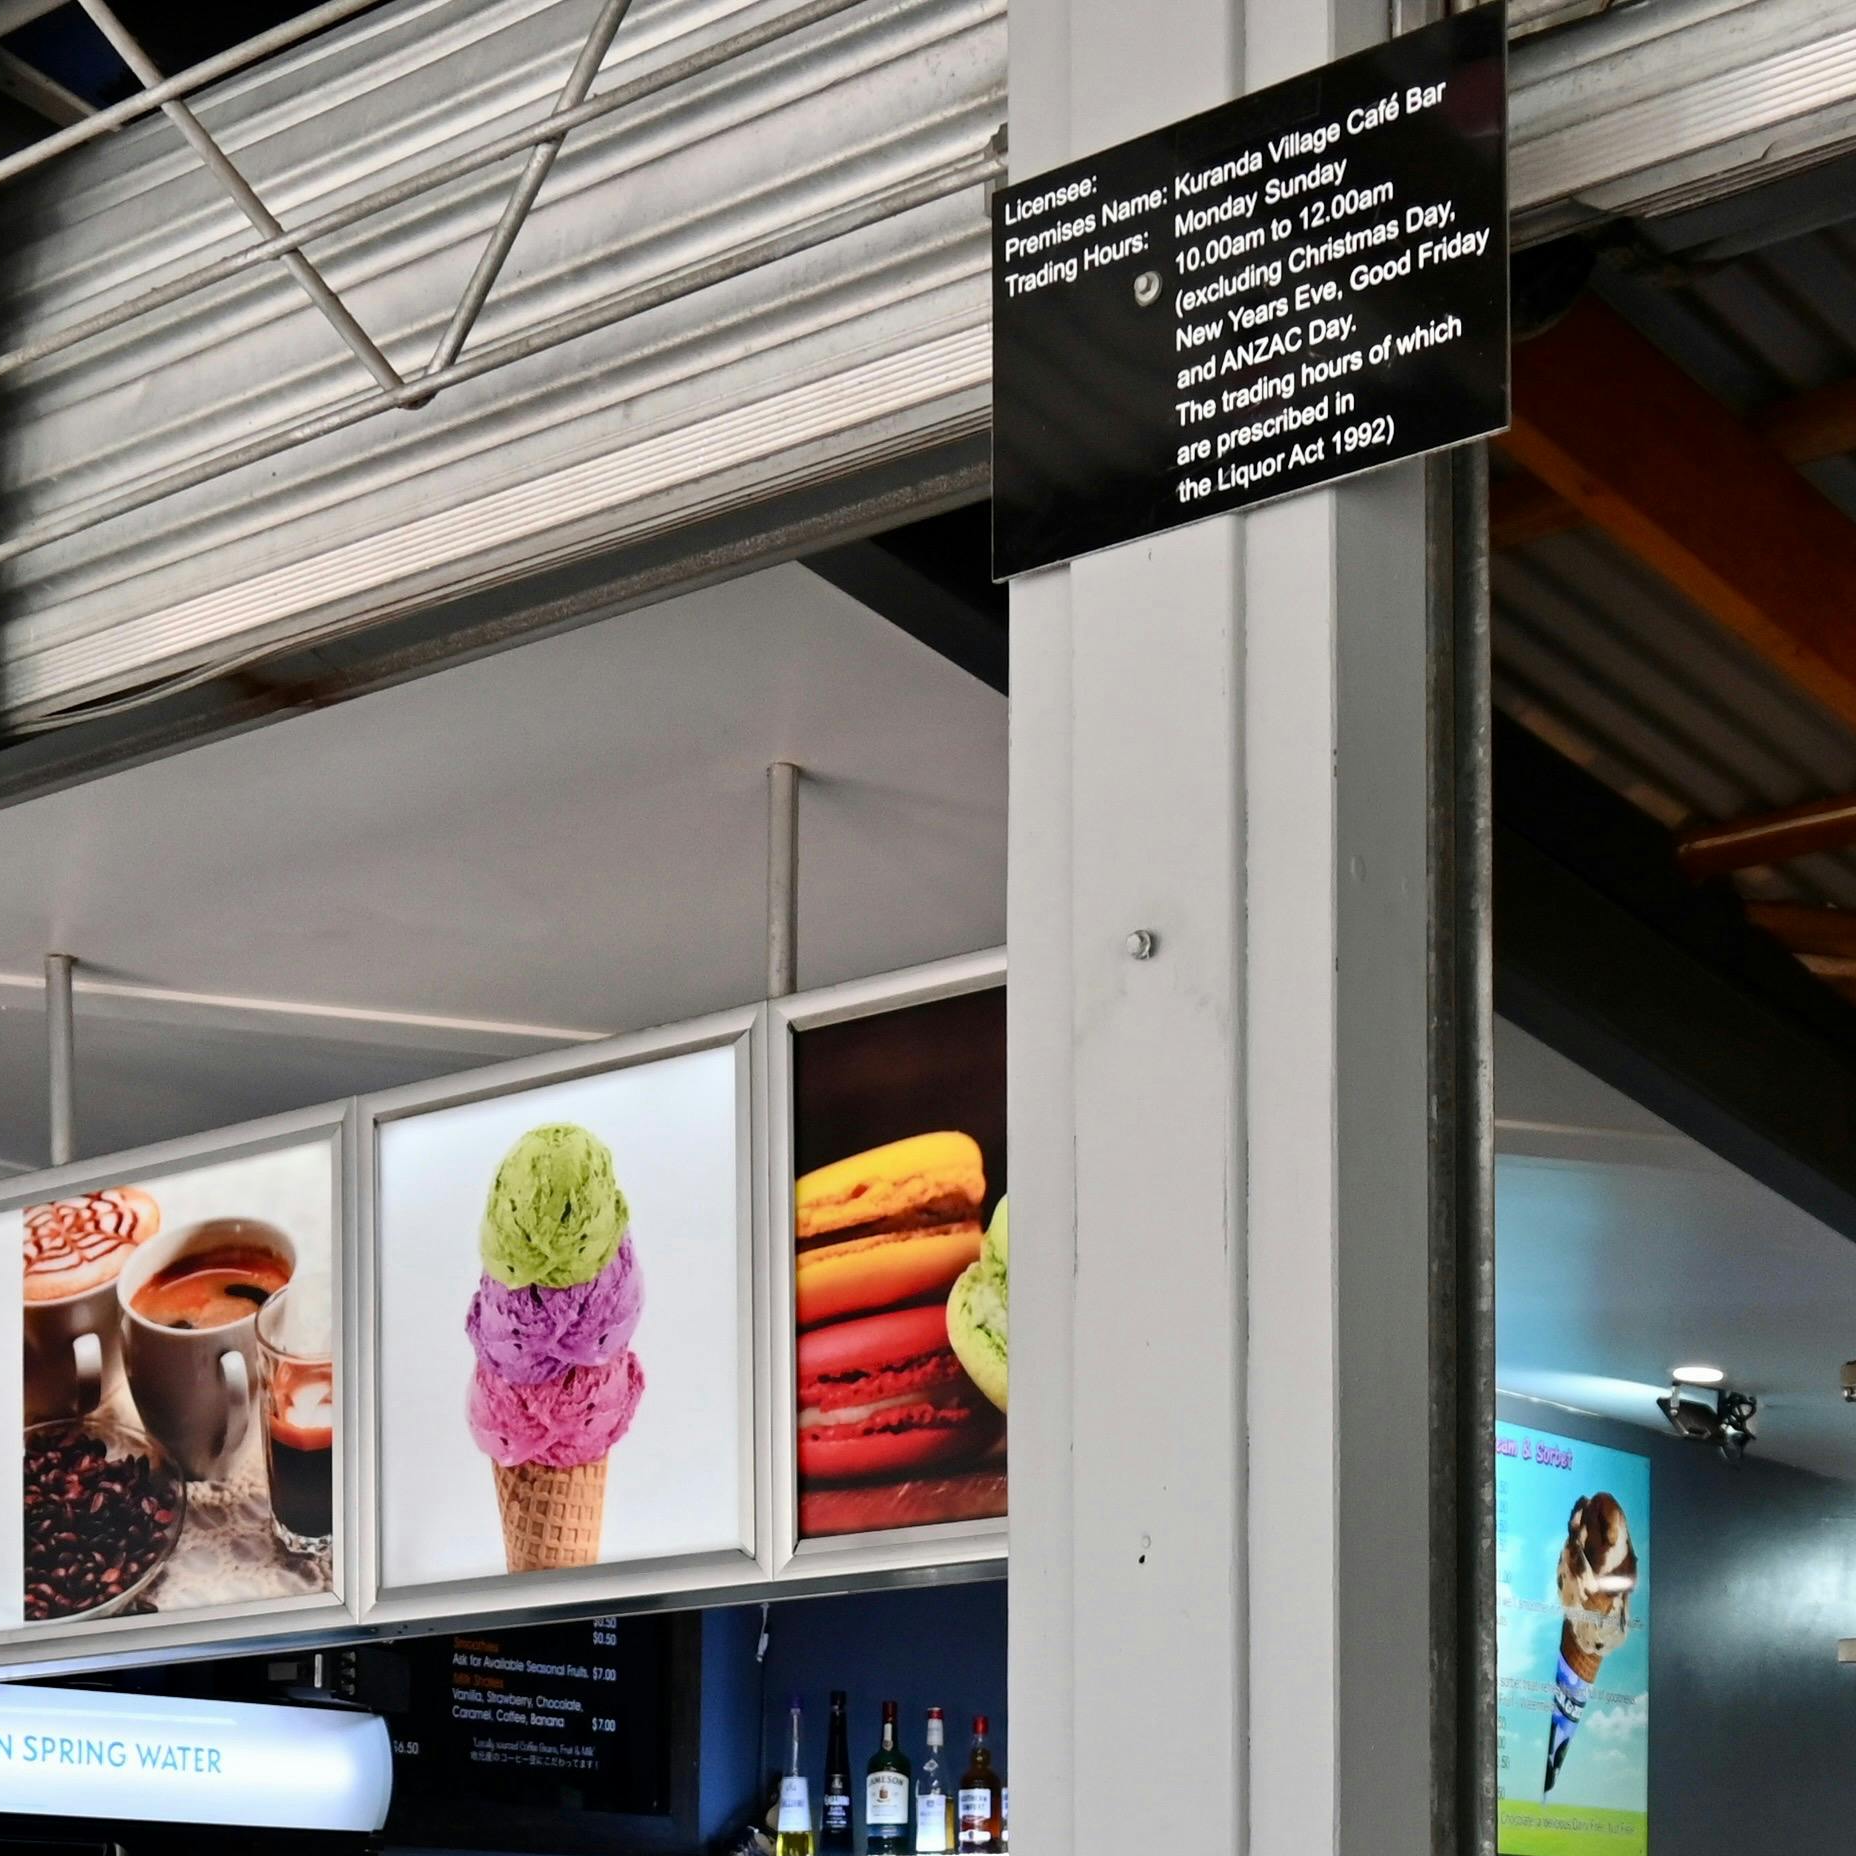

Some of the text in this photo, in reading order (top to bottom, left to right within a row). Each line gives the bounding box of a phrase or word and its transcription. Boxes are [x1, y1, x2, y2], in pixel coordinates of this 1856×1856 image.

[1005, 83, 1446, 263] Premises Name: Kuranda Village Café Bar
[1005, 174, 1098, 226] Licensee:
[1005, 159, 1347, 298] Trading Hours: Monday Sunday
[1176, 182, 1393, 275] 10.00am to 12.00am
[1176, 202, 1456, 318] (excluding Christmas Day,
[1177, 227, 1490, 352] New Years Eve, Good Friday
[1177, 314, 1357, 390] and ANZAC Day.
[1177, 315, 1463, 427] The trading hours of which
[1177, 391, 1355, 466] are prescribed in
[1177, 415, 1395, 503] the Liquor Act 1992)
[453, 1654, 616, 1680] Ask for Available Seasonal $7.00
[23, 1736, 127, 1768] SPRING
[137, 1743, 221, 1773] WATER
[531, 1714, 564, 1727] Banana
